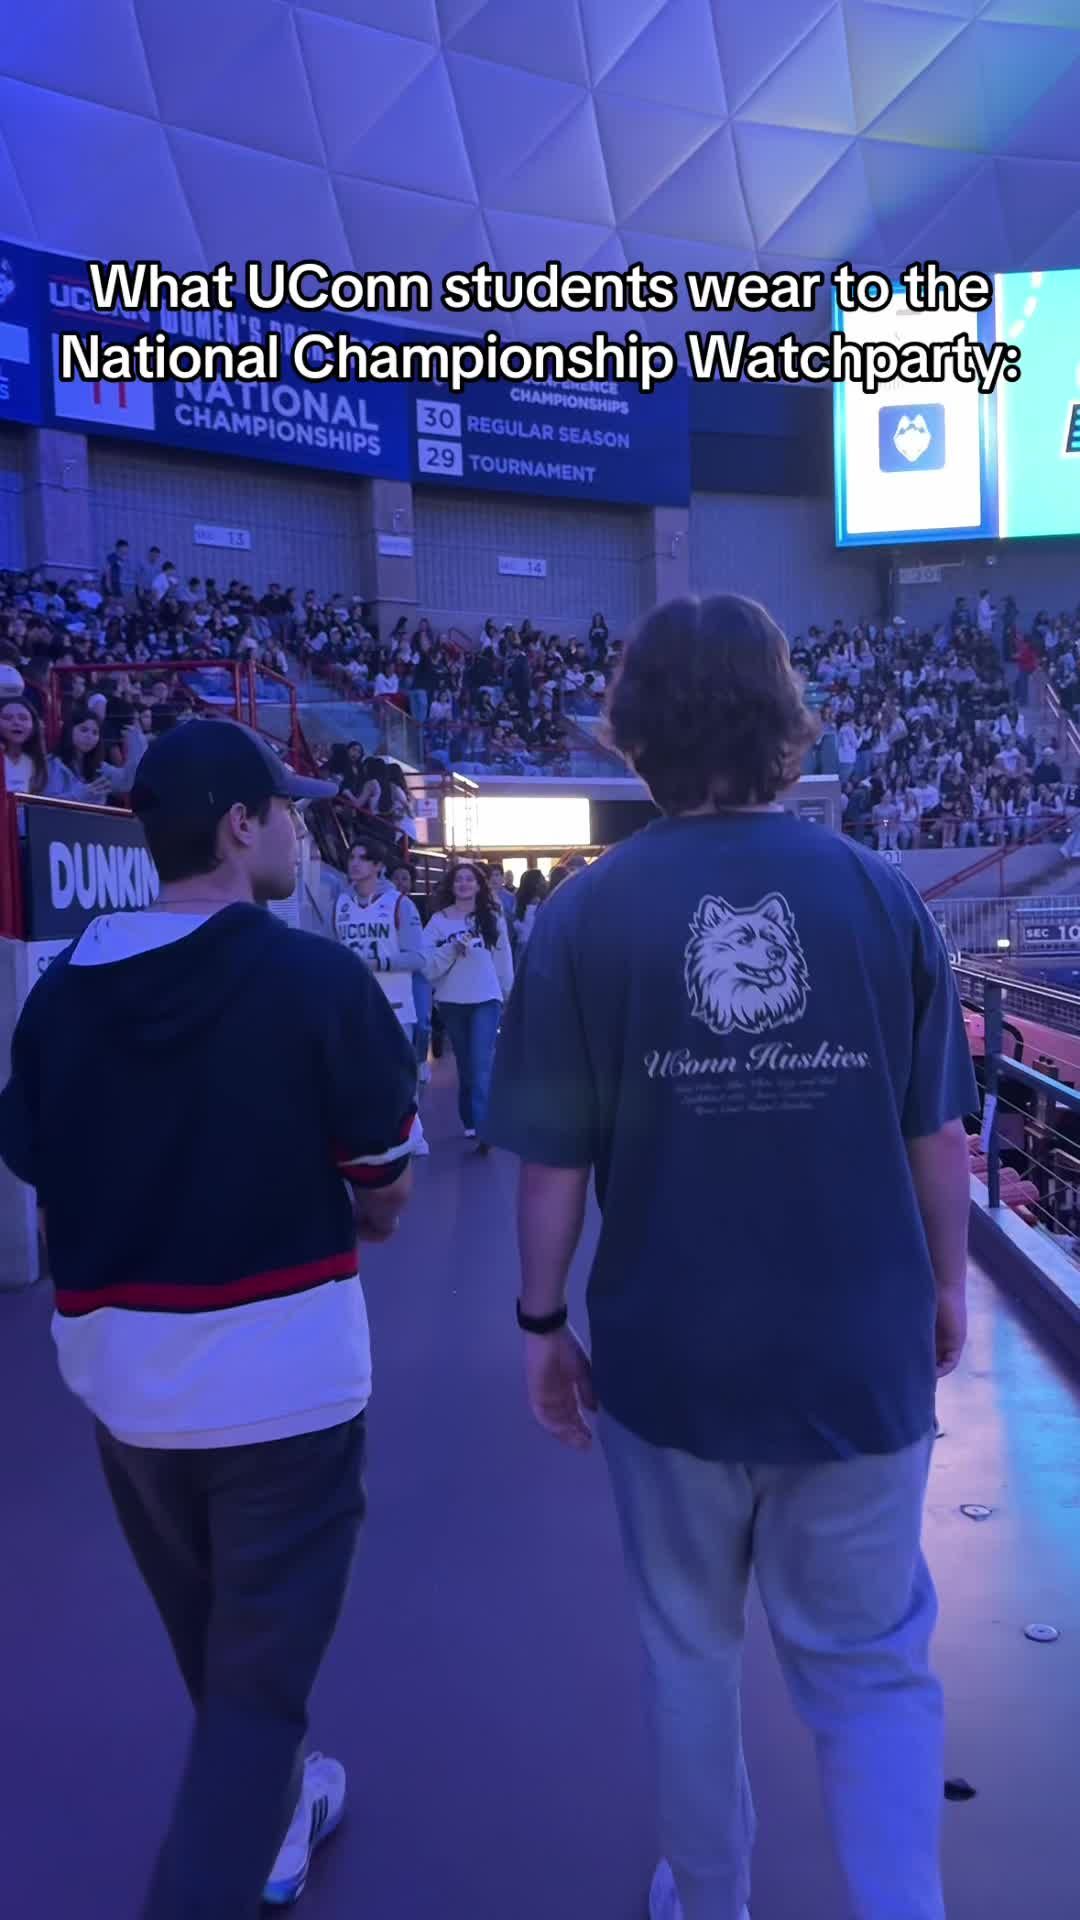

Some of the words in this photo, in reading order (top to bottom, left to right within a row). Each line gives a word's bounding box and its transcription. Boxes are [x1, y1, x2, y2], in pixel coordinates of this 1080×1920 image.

[175, 371, 379, 431] NATIONAL
[510, 388, 630, 416] CHAMPIONSHIPS
[174, 402, 381, 457] CHAMPIONSHIPS
[423, 408, 454, 430] 30
[467, 416, 554, 441] REGULAR
[559, 427, 630, 449] SEASON
[426, 448, 455, 468] 29
[470, 455, 596, 483] TOURNAMENT
[1026, 928, 1049, 939] SEC
[644, 1049, 737, 1079] UConn
[745, 1040, 871, 1072] Huskies
